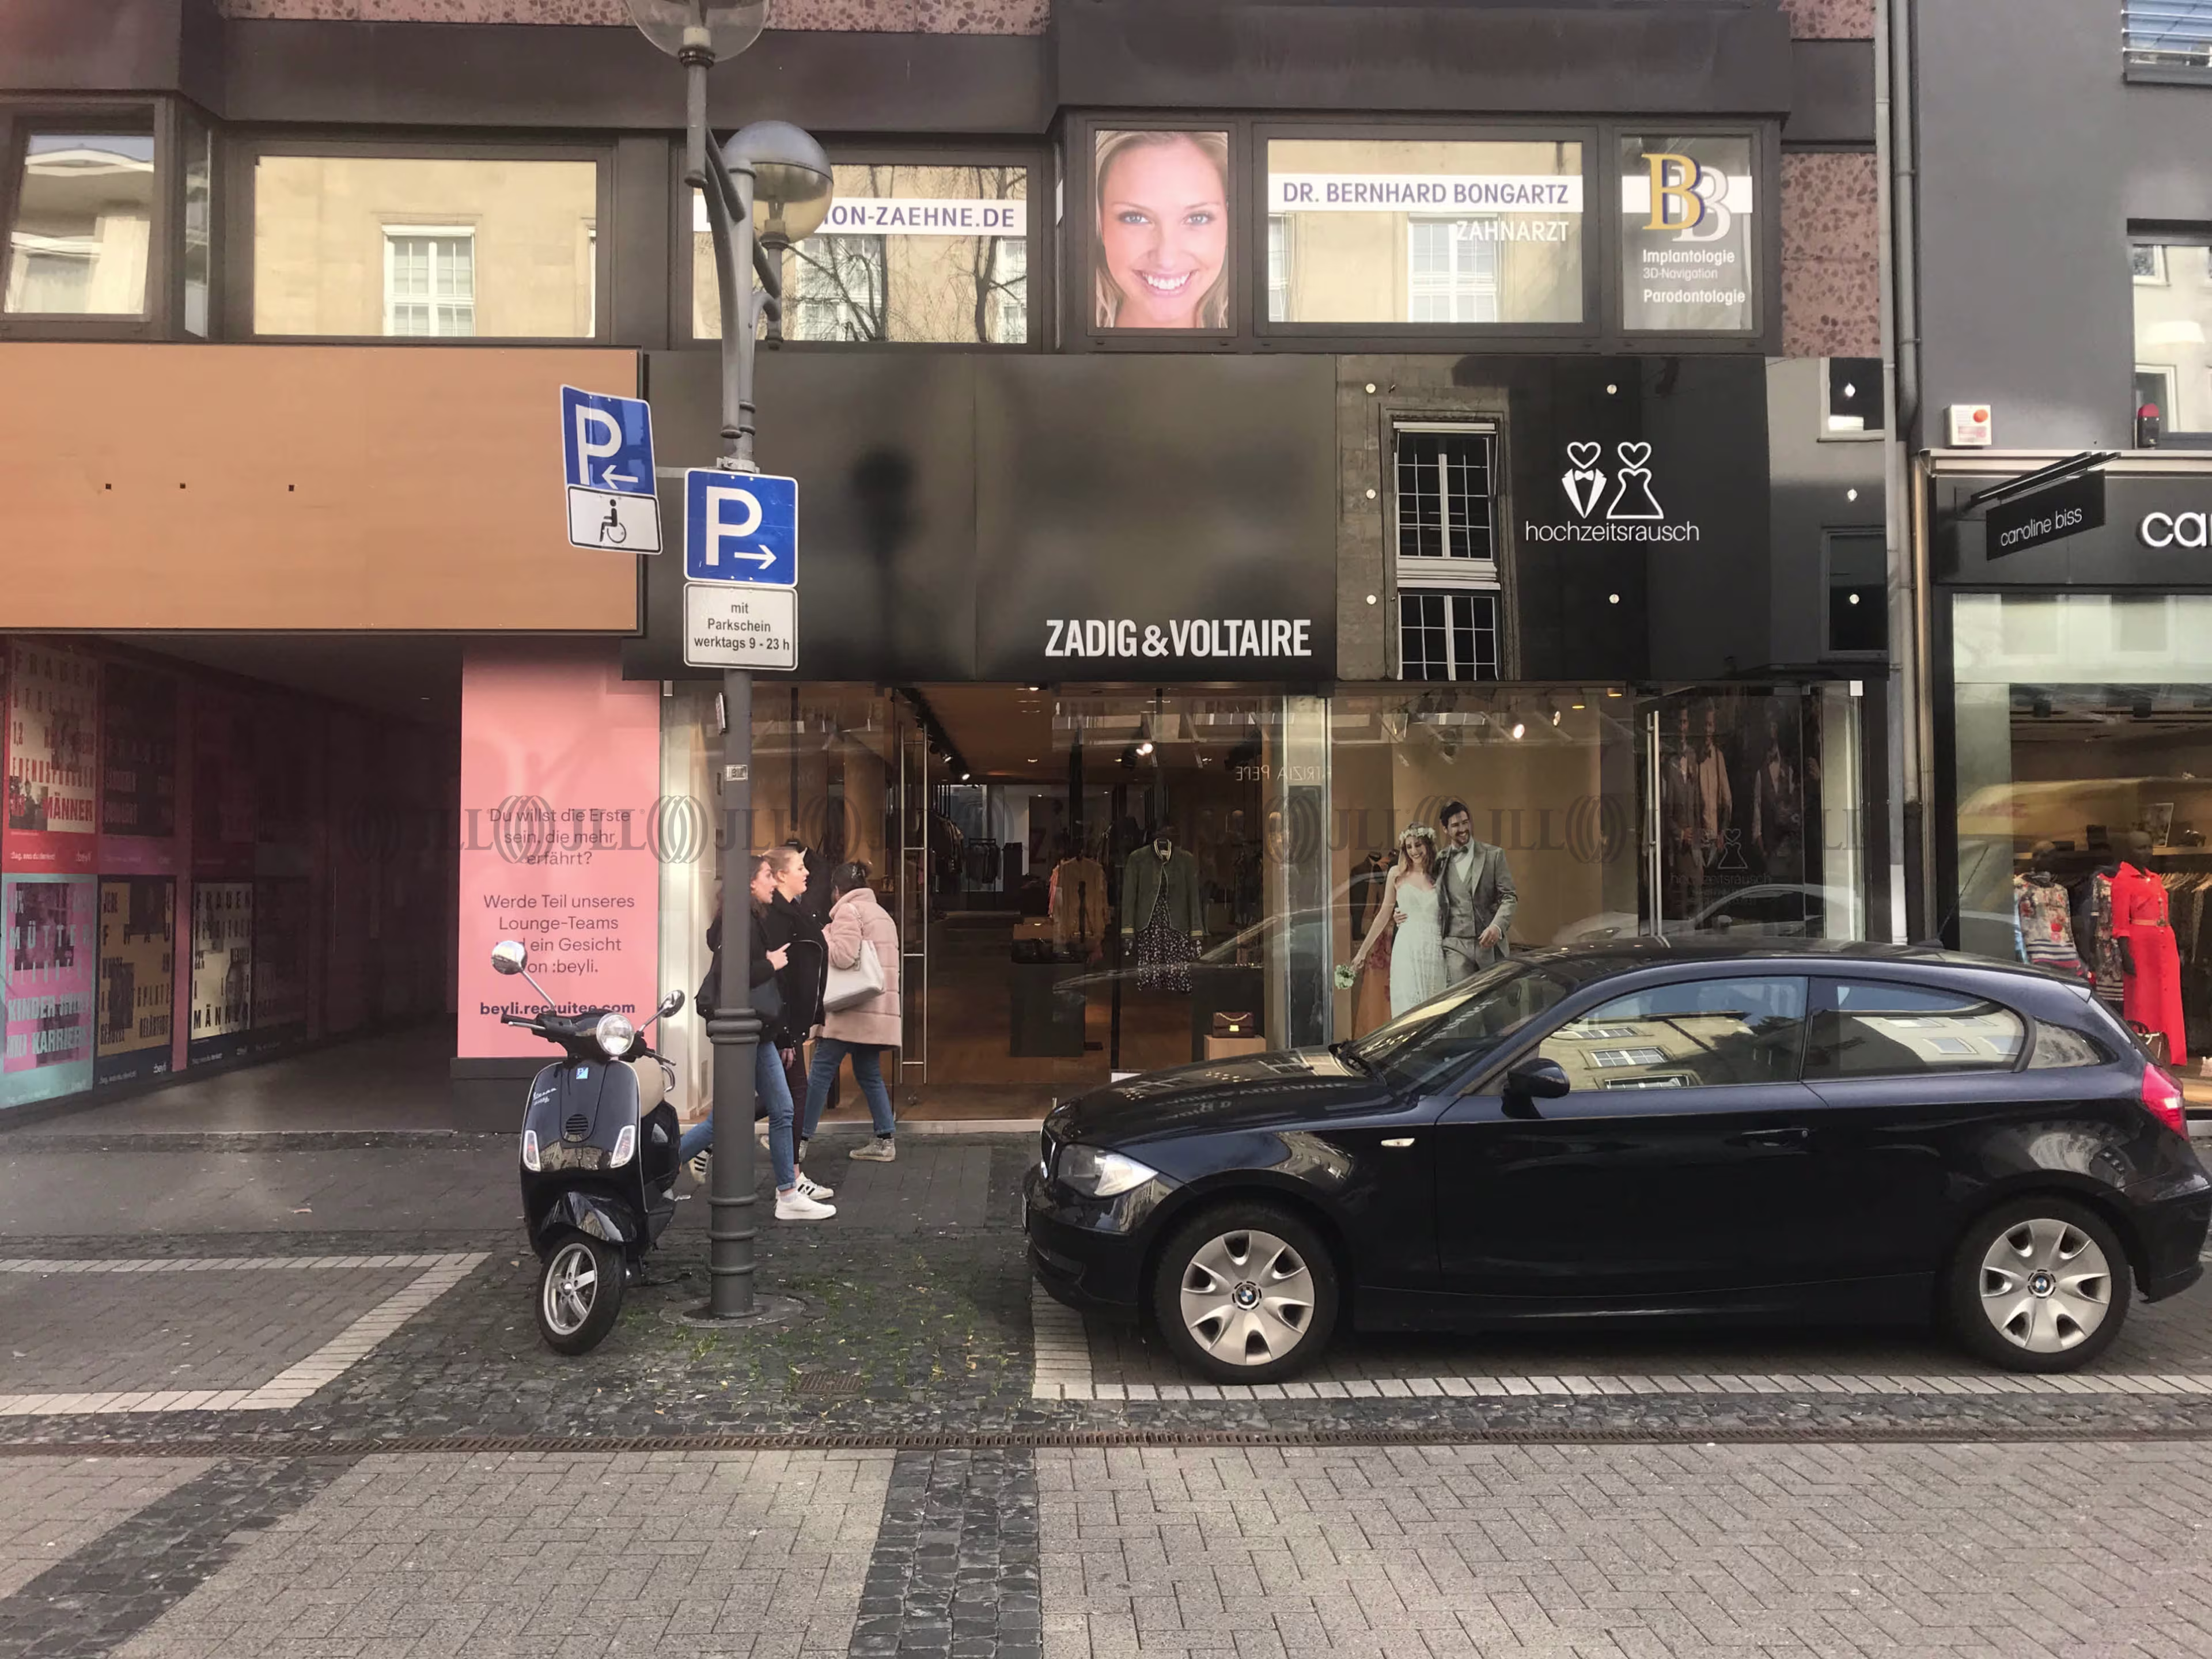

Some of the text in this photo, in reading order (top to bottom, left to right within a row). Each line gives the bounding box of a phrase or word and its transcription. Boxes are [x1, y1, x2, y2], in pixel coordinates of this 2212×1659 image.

[1283, 182, 1569, 204] DR. BERNHARD BONGARTZ
[1456, 221, 1569, 242] ZAHNARZT
[1643, 249, 1735, 266] Implantologie
[1643, 267, 1718, 281] 3D-Navigation
[1643, 289, 1745, 306] Parodontologie
[575, 404, 622, 486] P
[706, 486, 762, 566] P
[1525, 521, 1699, 541] hochzeitsrausch
[2001, 507, 2082, 546] caroline biss
[731, 602, 749, 614] mit
[707, 618, 771, 632] Parkschein
[694, 637, 746, 650] werktags
[749, 638, 756, 648] 9
[767, 638, 779, 650] 23
[783, 639, 789, 650] h
[490, 808, 630, 822] Du willst die Erste
[505, 830, 615, 845] sein, die mehr
[527, 851, 592, 865] erfährt?
[483, 894, 635, 908] Werde Teil unseres
[499, 916, 618, 933] Lounge-Teams
[9, 921, 89, 950] MÜTTER
[530, 938, 554, 952] ein
[558, 937, 622, 952] Gesicht
[527, 959, 598, 976] on :beyli.
